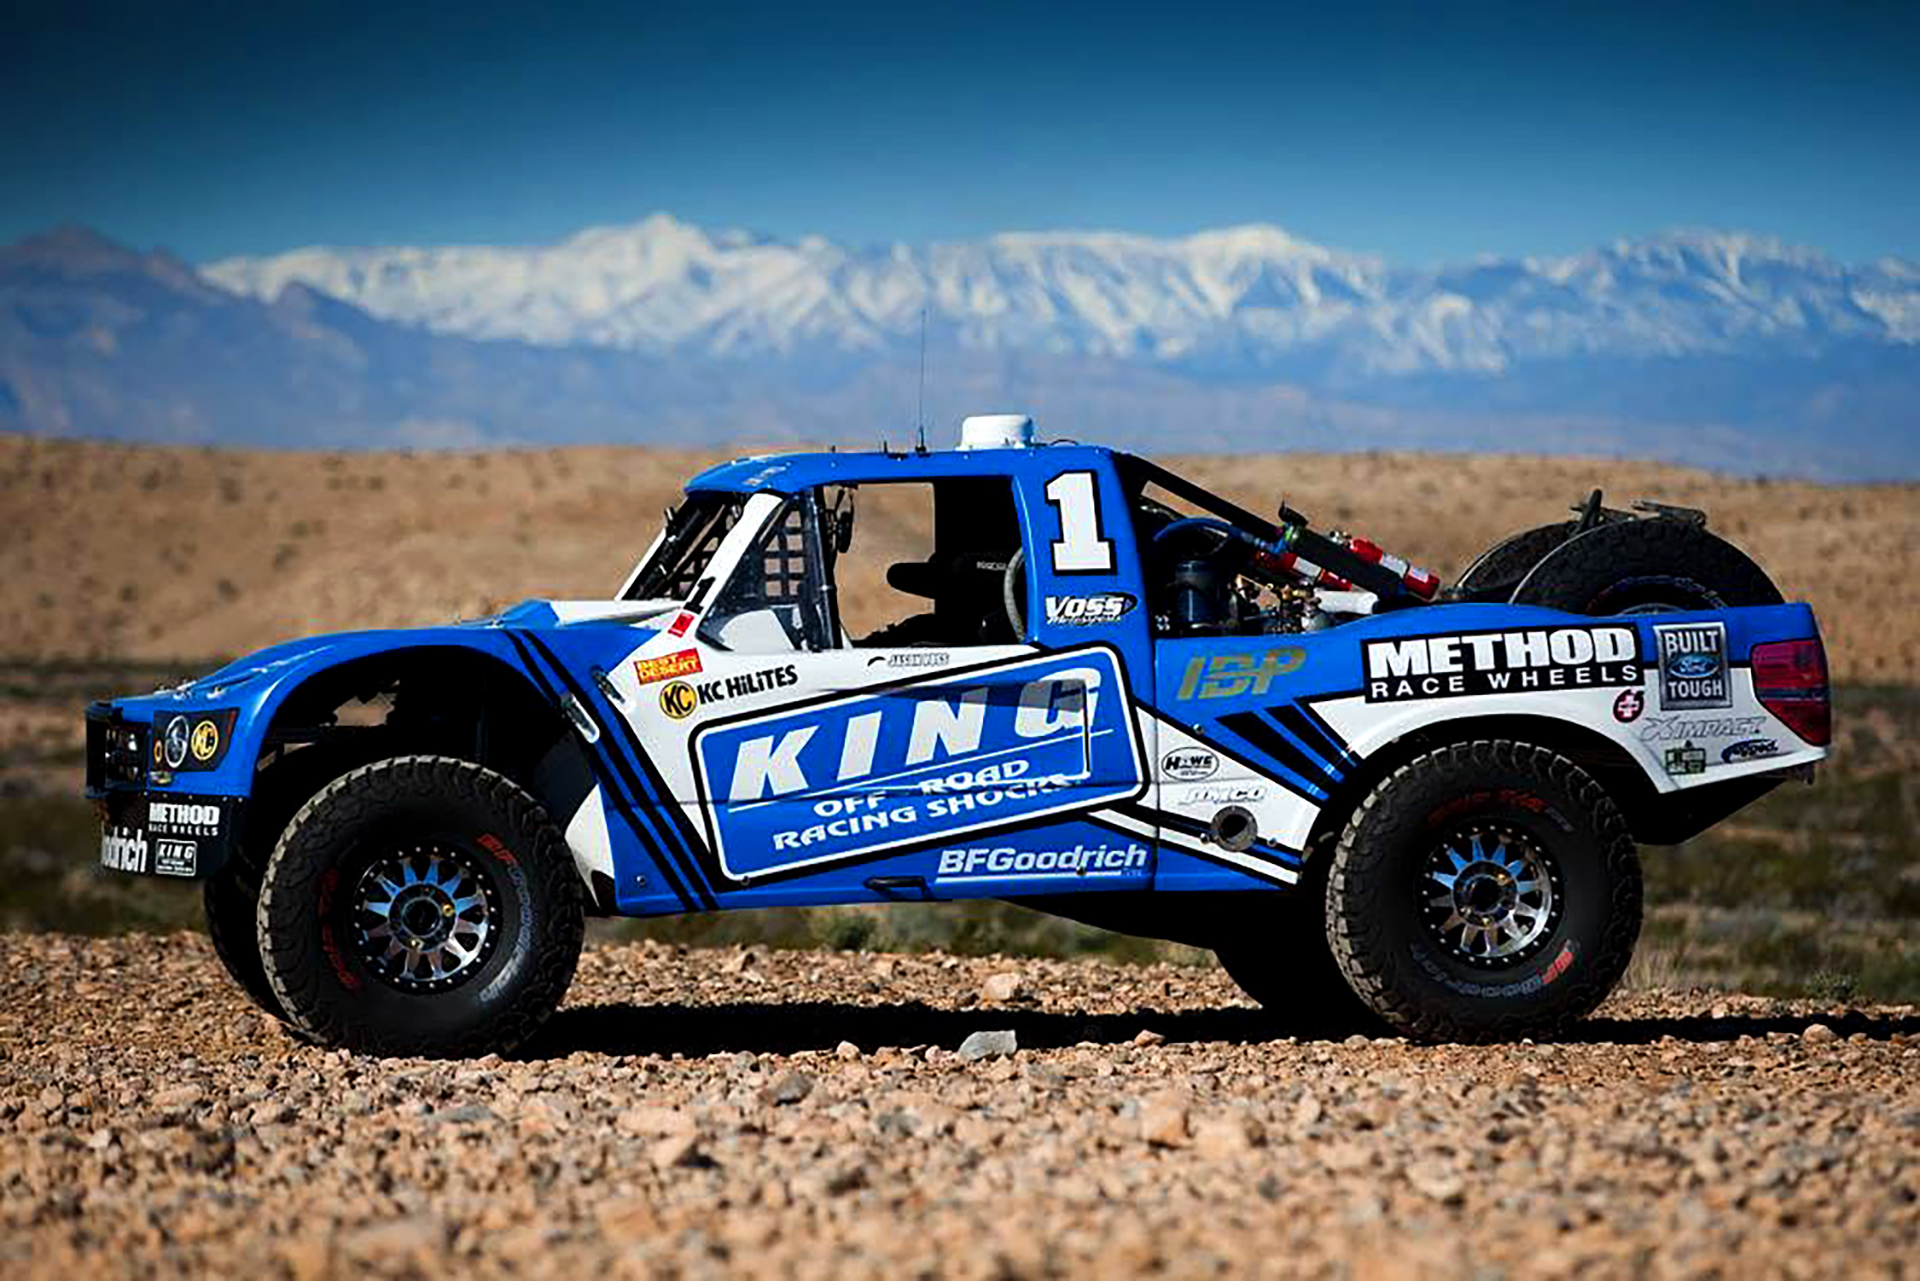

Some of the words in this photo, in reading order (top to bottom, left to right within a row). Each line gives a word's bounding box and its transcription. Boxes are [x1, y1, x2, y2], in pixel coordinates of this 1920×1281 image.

[1046, 472, 1112, 571] 1
[1045, 596, 1124, 617] VOSS
[1368, 628, 1636, 678] METHOD
[1664, 631, 1718, 657] BUILT
[697, 681, 725, 705] KC
[1371, 677, 1465, 699] RACE
[1488, 664, 1638, 689] WHEELS
[1668, 680, 1723, 699] TOUGH
[664, 684, 693, 715] KC
[727, 668, 1102, 801] KING
[814, 790, 887, 817] OFF
[919, 760, 1029, 793] ROAD
[149, 802, 220, 825] METHOD
[772, 806, 917, 850] RACING
[937, 844, 1147, 873] BFGoodrich
